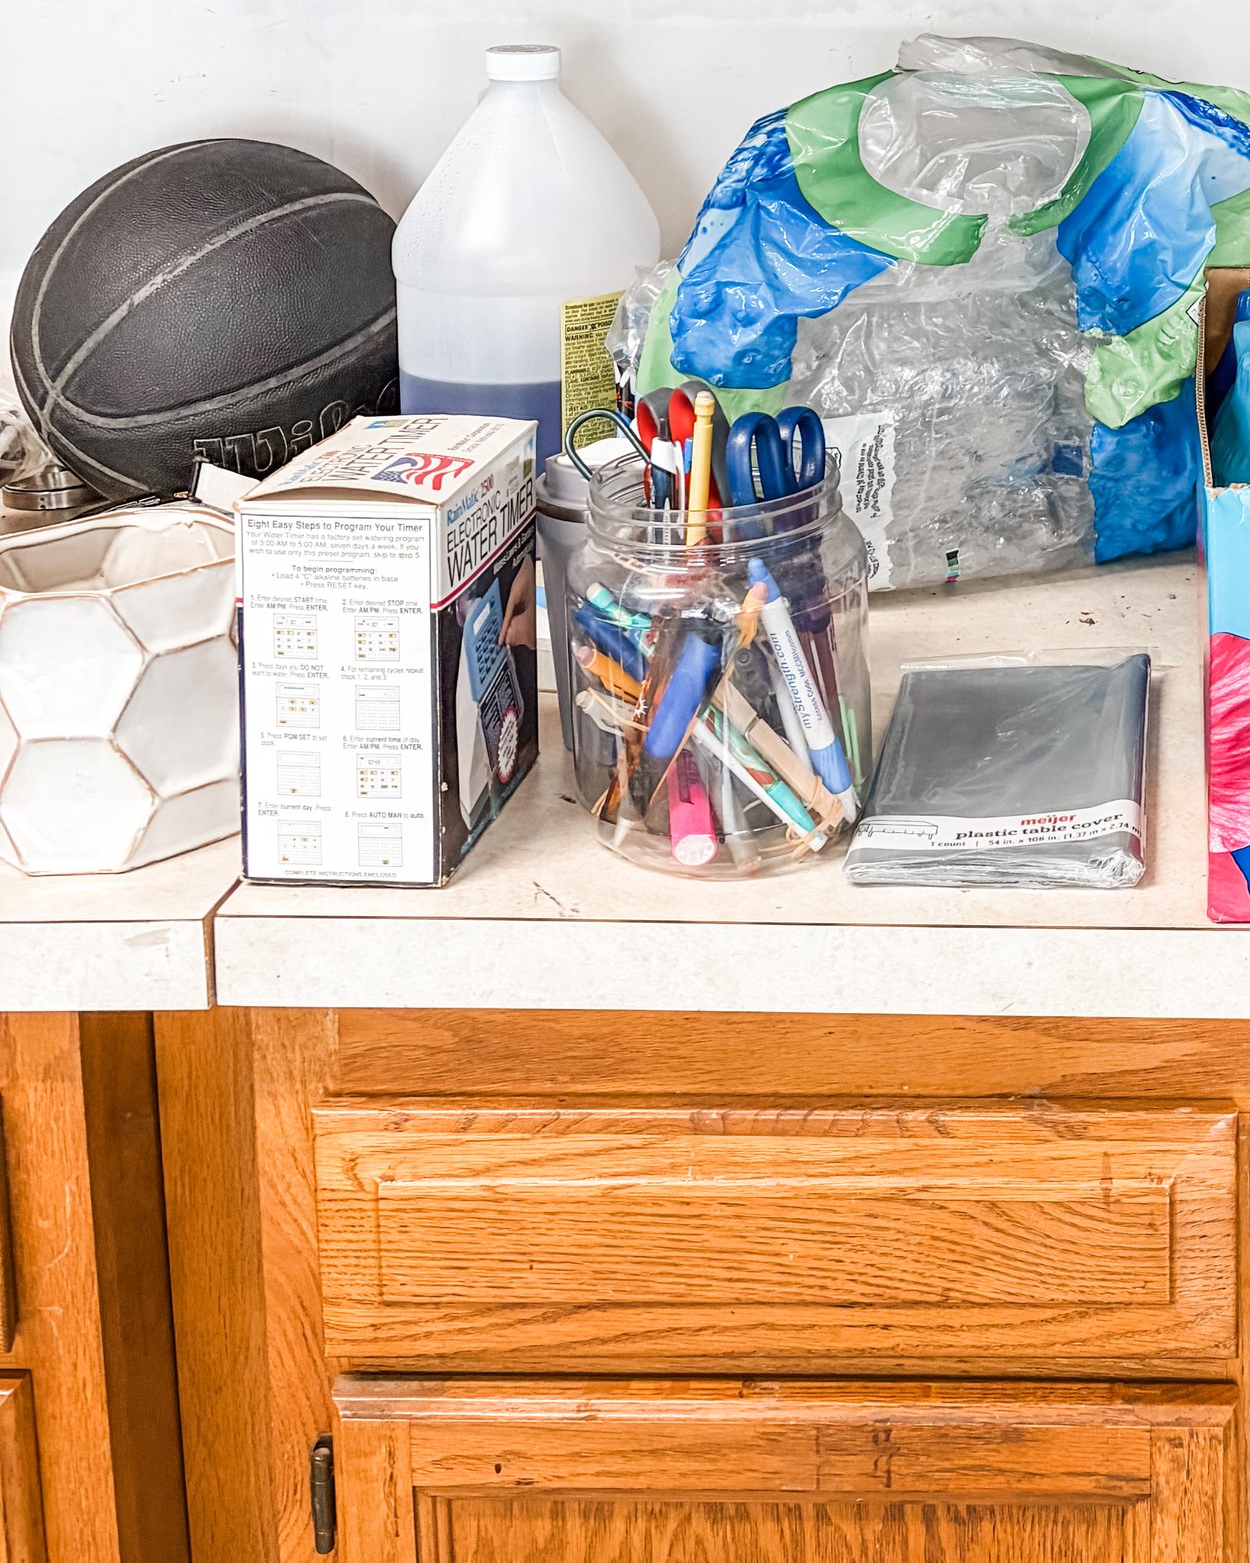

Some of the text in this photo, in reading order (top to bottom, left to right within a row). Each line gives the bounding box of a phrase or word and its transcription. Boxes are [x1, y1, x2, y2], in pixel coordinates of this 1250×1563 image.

[247, 519, 423, 532] Eight Easy Steps to Program Your Timer
[447, 490, 501, 553] ELECTRONIC
[447, 478, 534, 588] WATER TIMER
[303, 565, 324, 574] begin
[325, 566, 377, 575] programming:
[770, 632, 812, 729] myStrength.com
[956, 813, 1124, 840] plastic table cover
[1020, 814, 1076, 826] meijer
